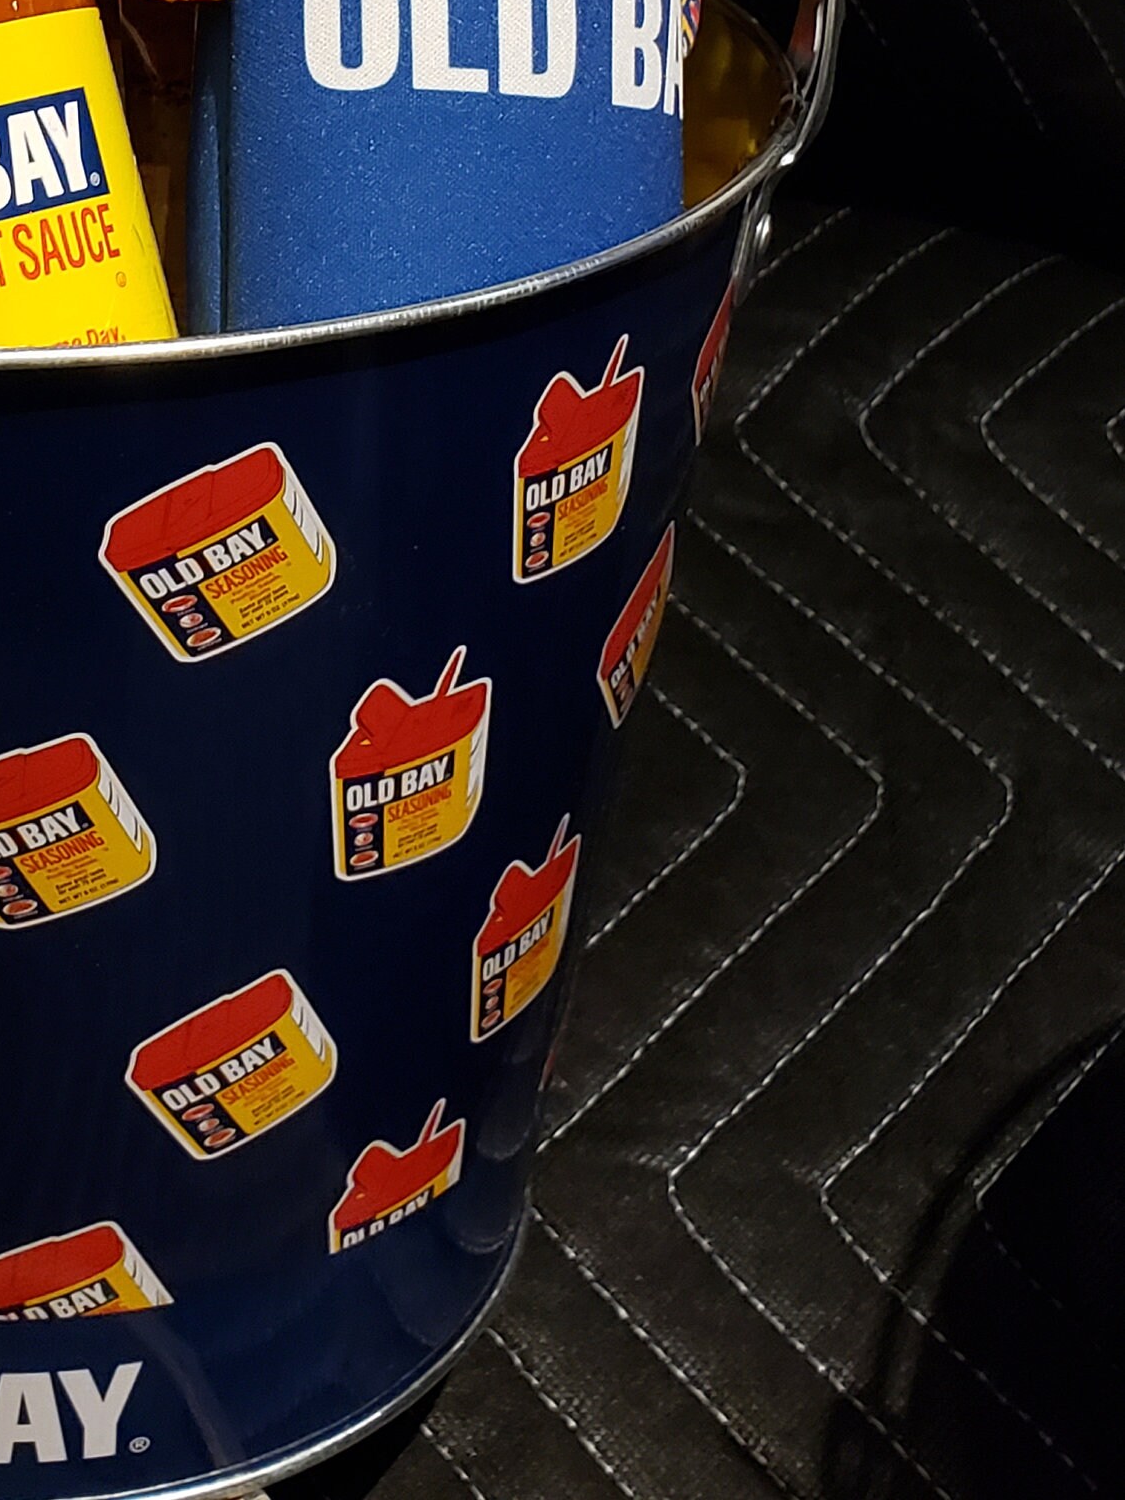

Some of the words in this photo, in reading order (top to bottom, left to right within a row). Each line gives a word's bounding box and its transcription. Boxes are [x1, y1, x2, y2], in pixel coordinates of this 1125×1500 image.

[12, 203, 121, 281] SAUCE
[526, 477, 565, 512] OLD
[569, 448, 609, 494] BAY
[139, 556, 204, 600] OLD
[203, 521, 266, 573] BAY
[205, 545, 289, 600] SEASONING
[346, 776, 394, 812] OLD
[400, 754, 450, 798] BAY
[16, 806, 80, 850] BAY
[20, 830, 106, 875] SEASONING
[161, 1074, 222, 1112] OLD
[219, 1036, 277, 1083] BAY
[48, 1282, 108, 1319] BAY
